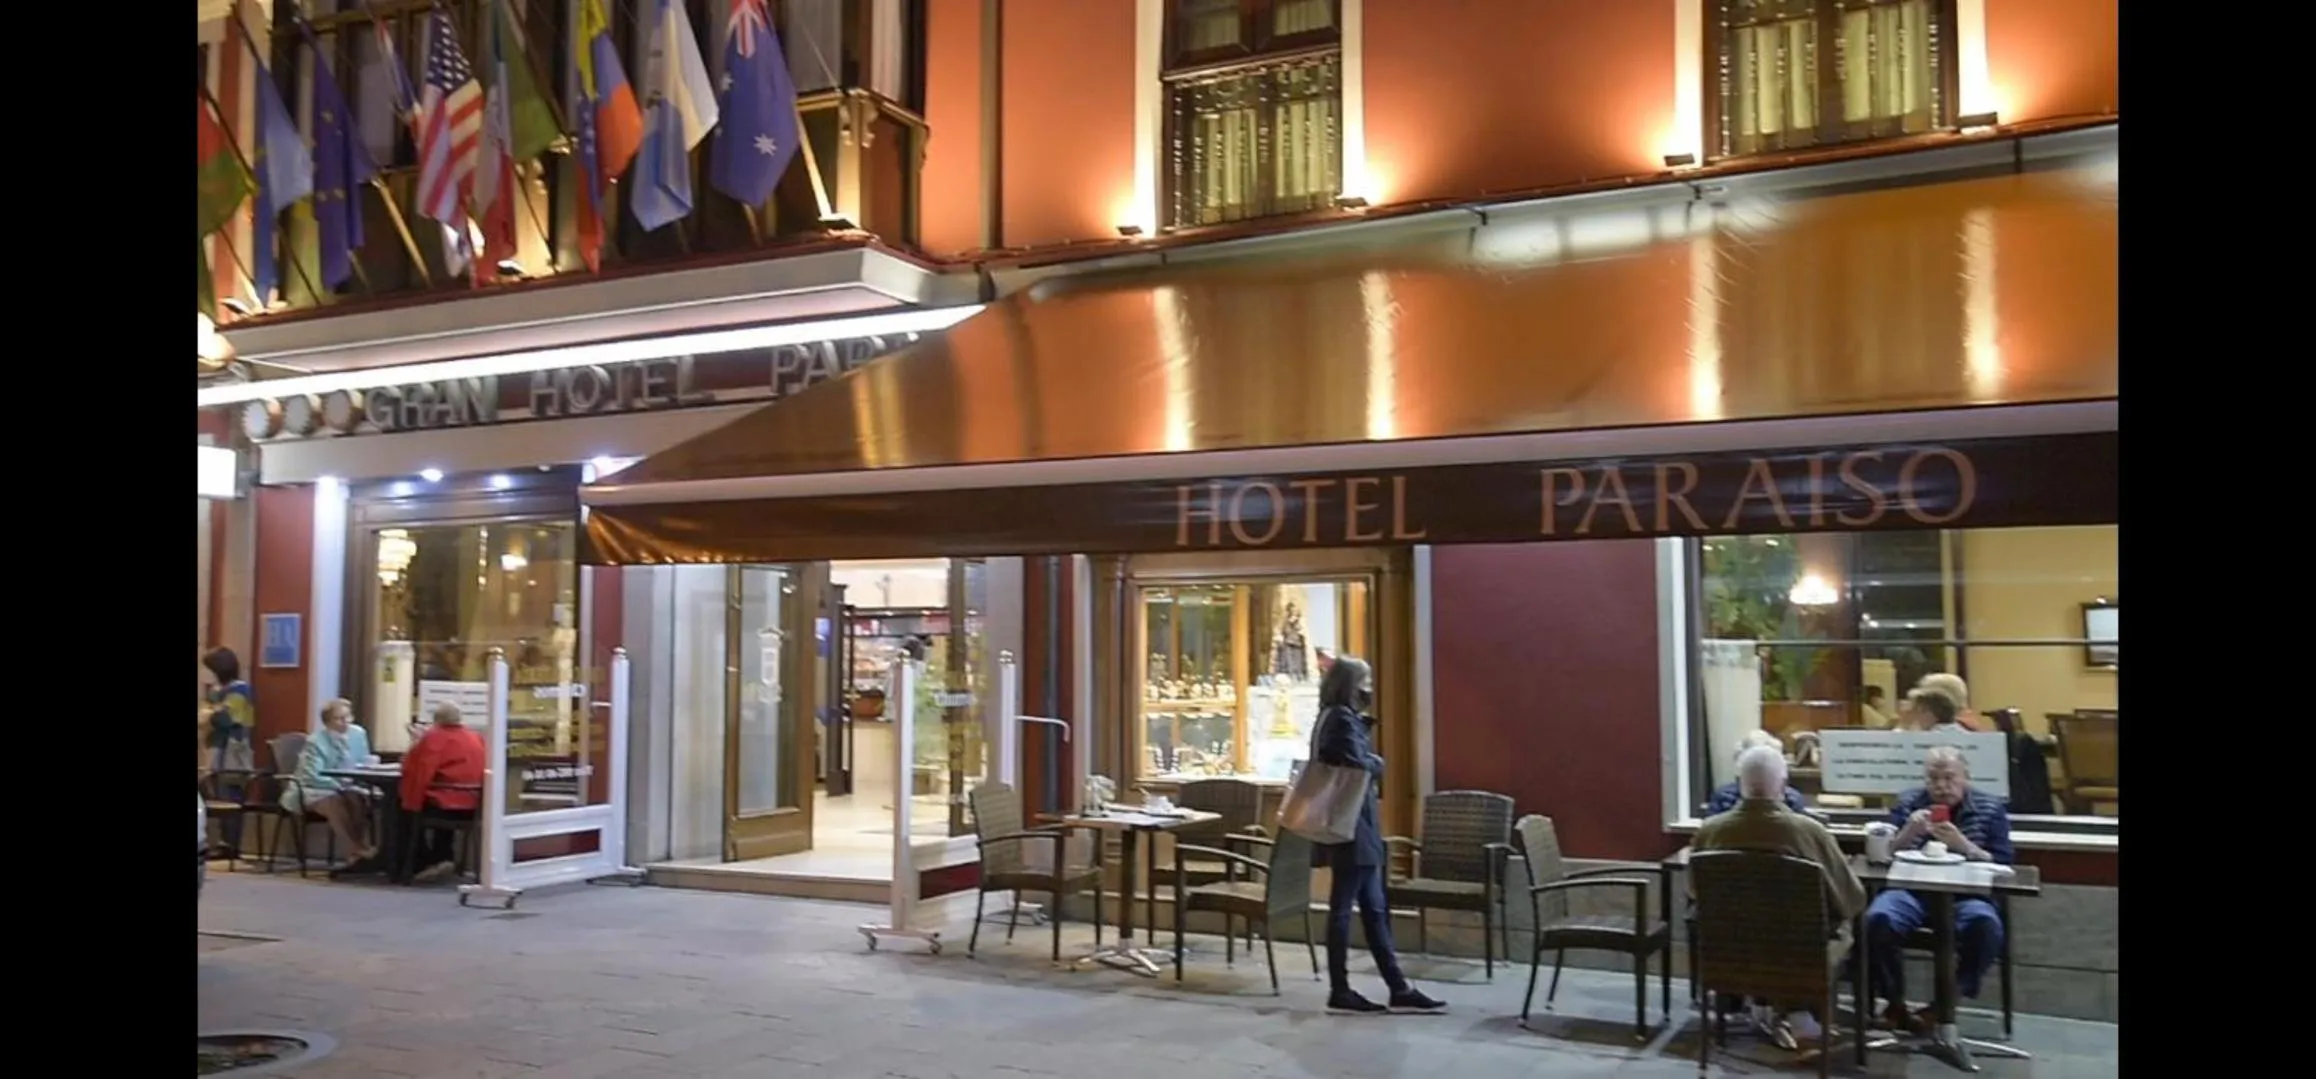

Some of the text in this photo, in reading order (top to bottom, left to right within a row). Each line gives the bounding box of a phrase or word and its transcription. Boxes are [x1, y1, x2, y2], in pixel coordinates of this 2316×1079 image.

[364, 375, 499, 432] GRAN
[530, 355, 706, 416] HOTEL
[1175, 447, 1977, 546] HOTEL PARAISO
